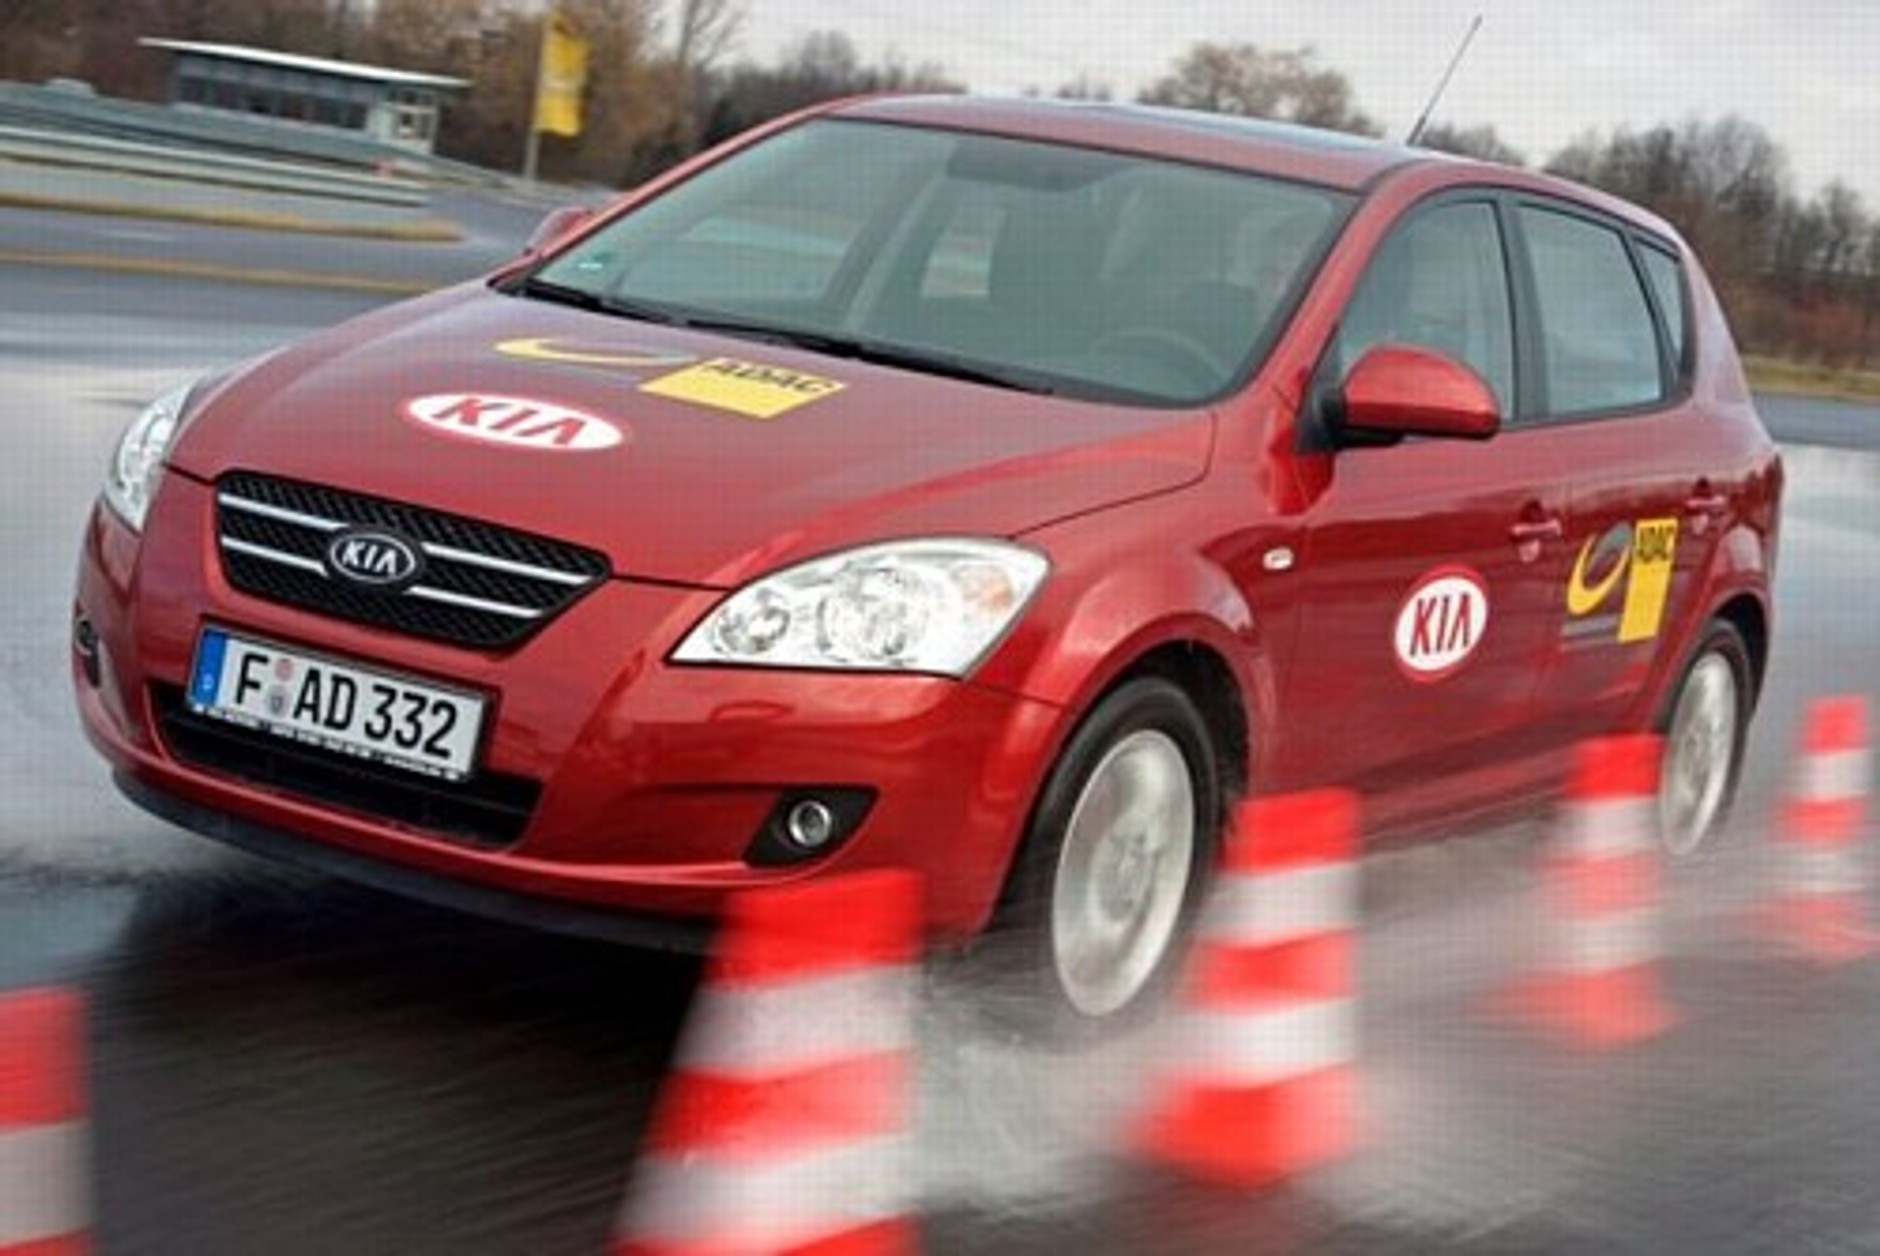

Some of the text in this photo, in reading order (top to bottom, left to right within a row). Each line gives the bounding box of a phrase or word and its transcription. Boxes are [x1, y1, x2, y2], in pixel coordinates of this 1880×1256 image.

[431, 395, 587, 447] KIA
[342, 541, 397, 576] KIA
[1409, 592, 1472, 657] KIA
[235, 653, 268, 704] F
[293, 668, 357, 731] AD
[364, 683, 457, 759] 332
